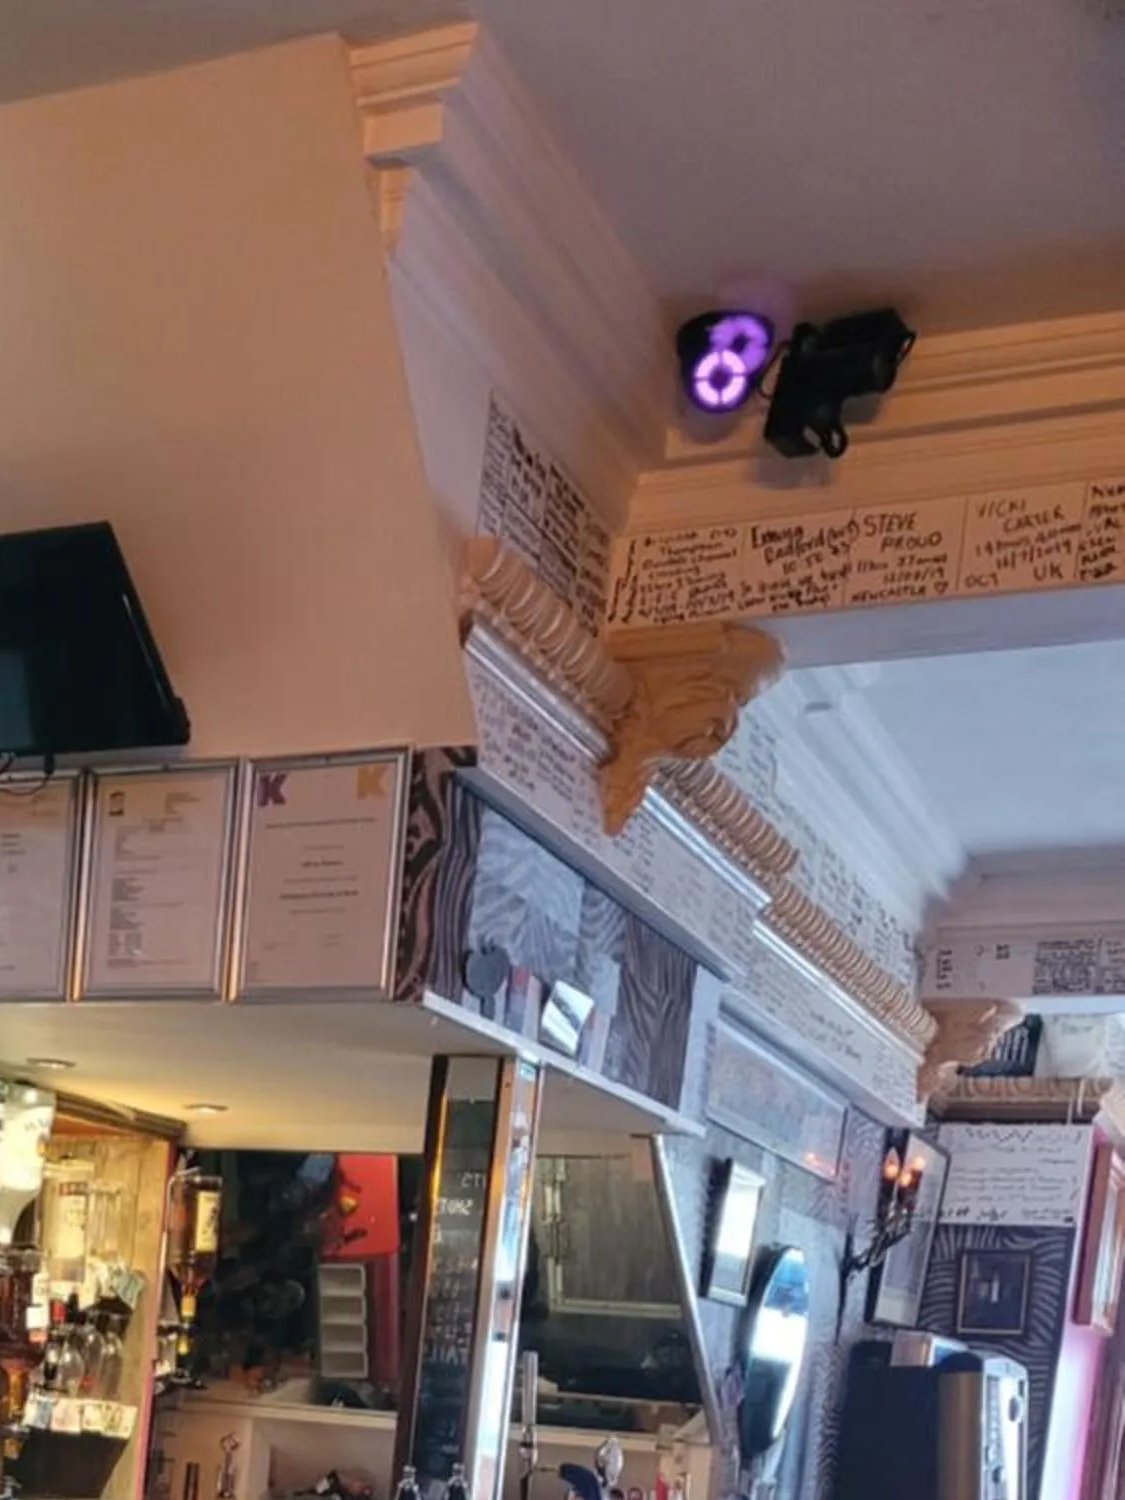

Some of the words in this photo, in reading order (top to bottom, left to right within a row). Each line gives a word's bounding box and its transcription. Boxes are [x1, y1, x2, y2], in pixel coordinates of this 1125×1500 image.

[864, 511, 917, 537] STEVE
[257, 771, 288, 807] K
[356, 764, 389, 800] K
